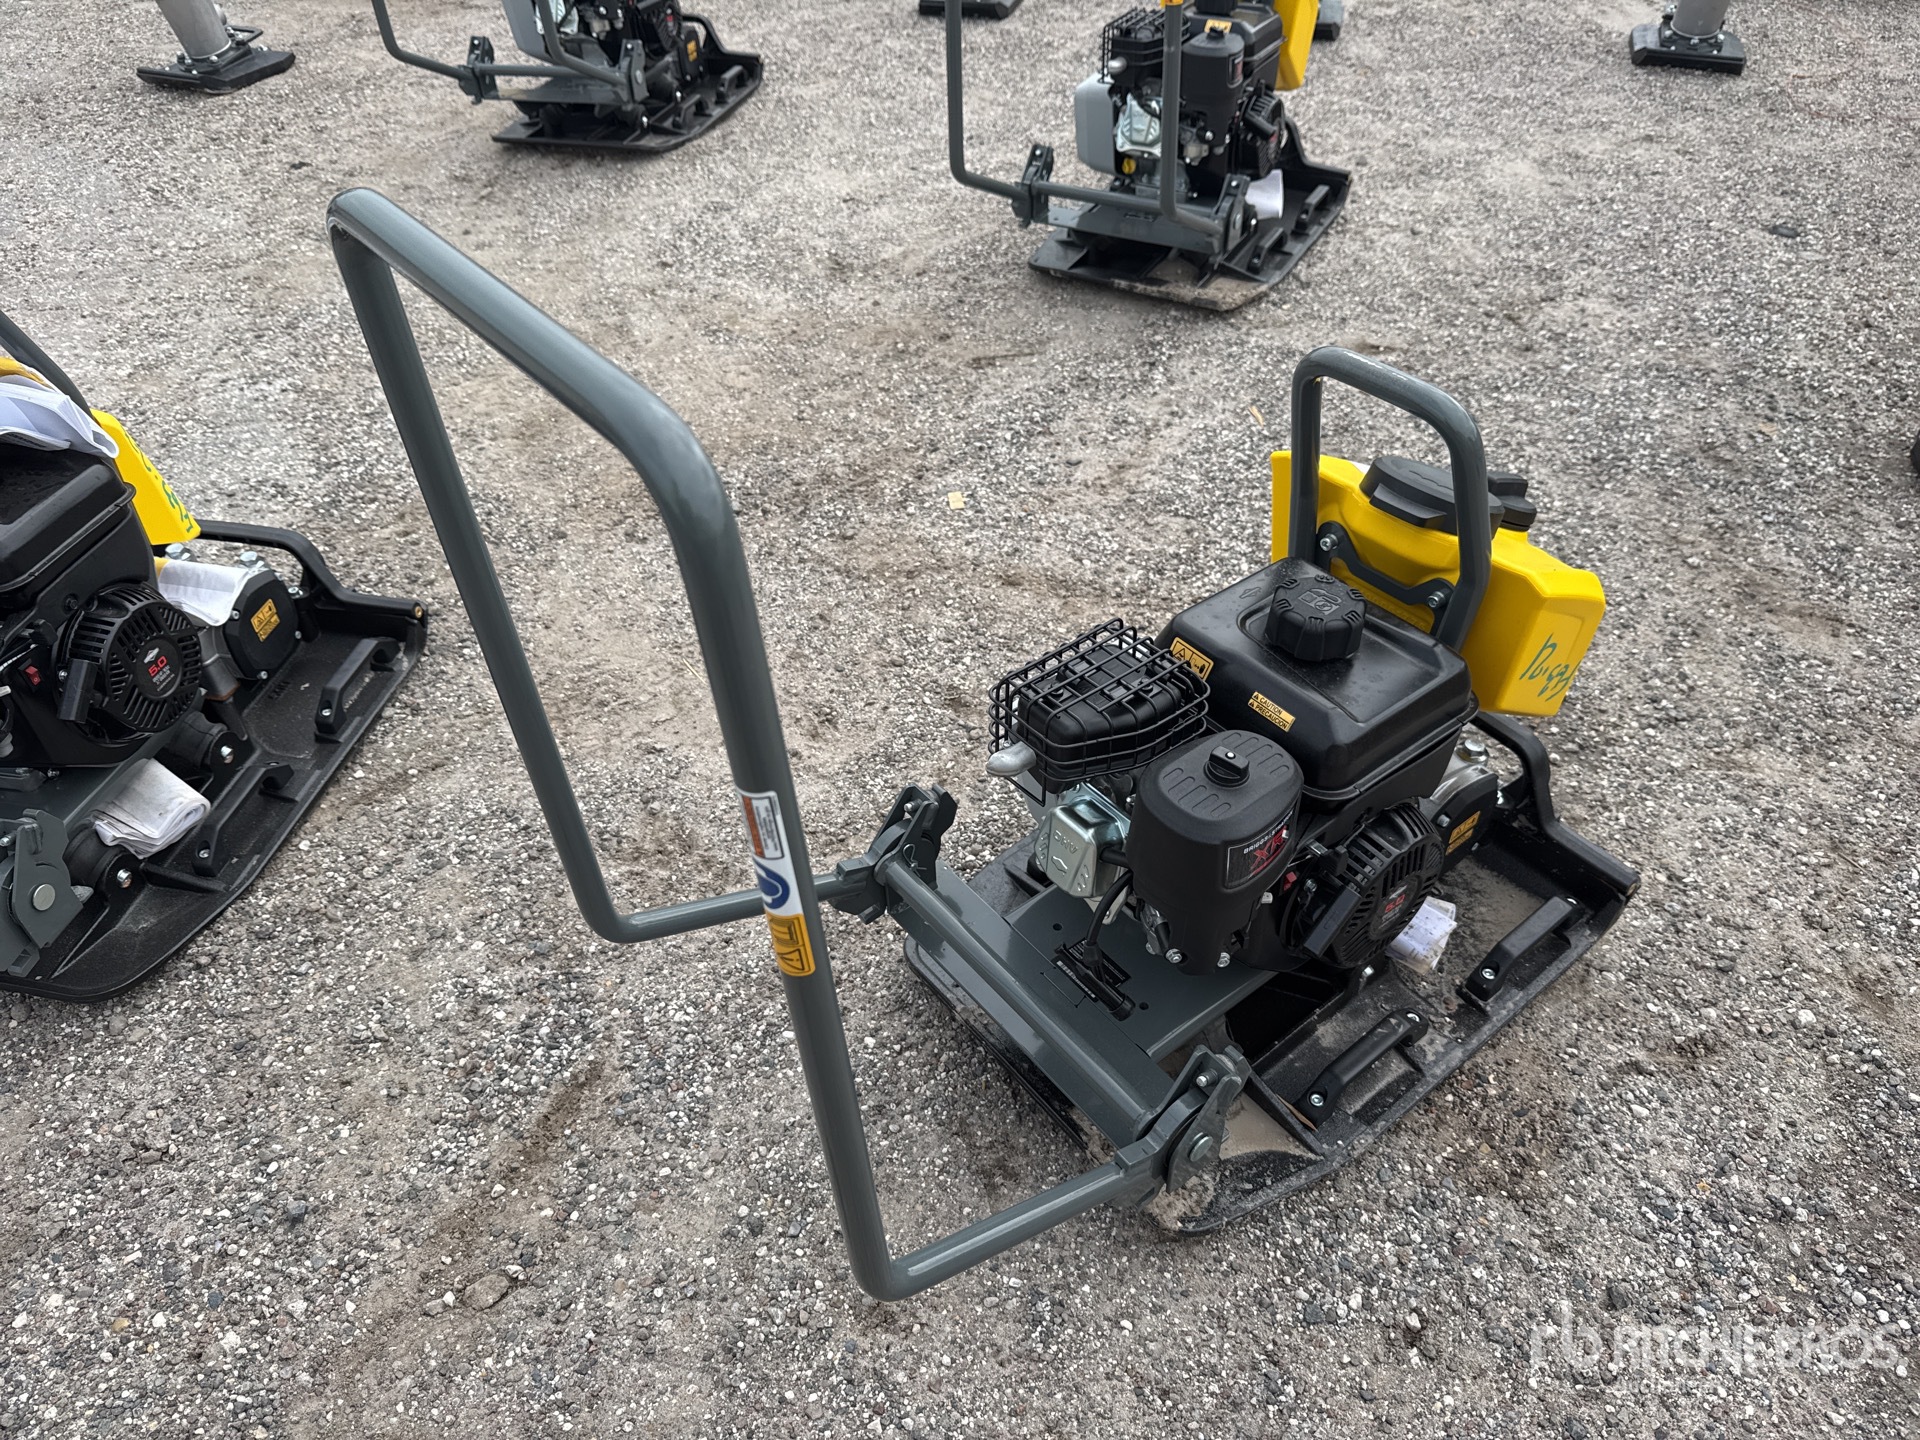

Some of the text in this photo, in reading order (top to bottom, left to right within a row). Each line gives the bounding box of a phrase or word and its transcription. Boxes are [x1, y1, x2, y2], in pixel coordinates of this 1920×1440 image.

[148, 655, 167, 676] 5.0
[1260, 698, 1283, 715] CAUTION
[1053, 830, 1078, 855] OHV
